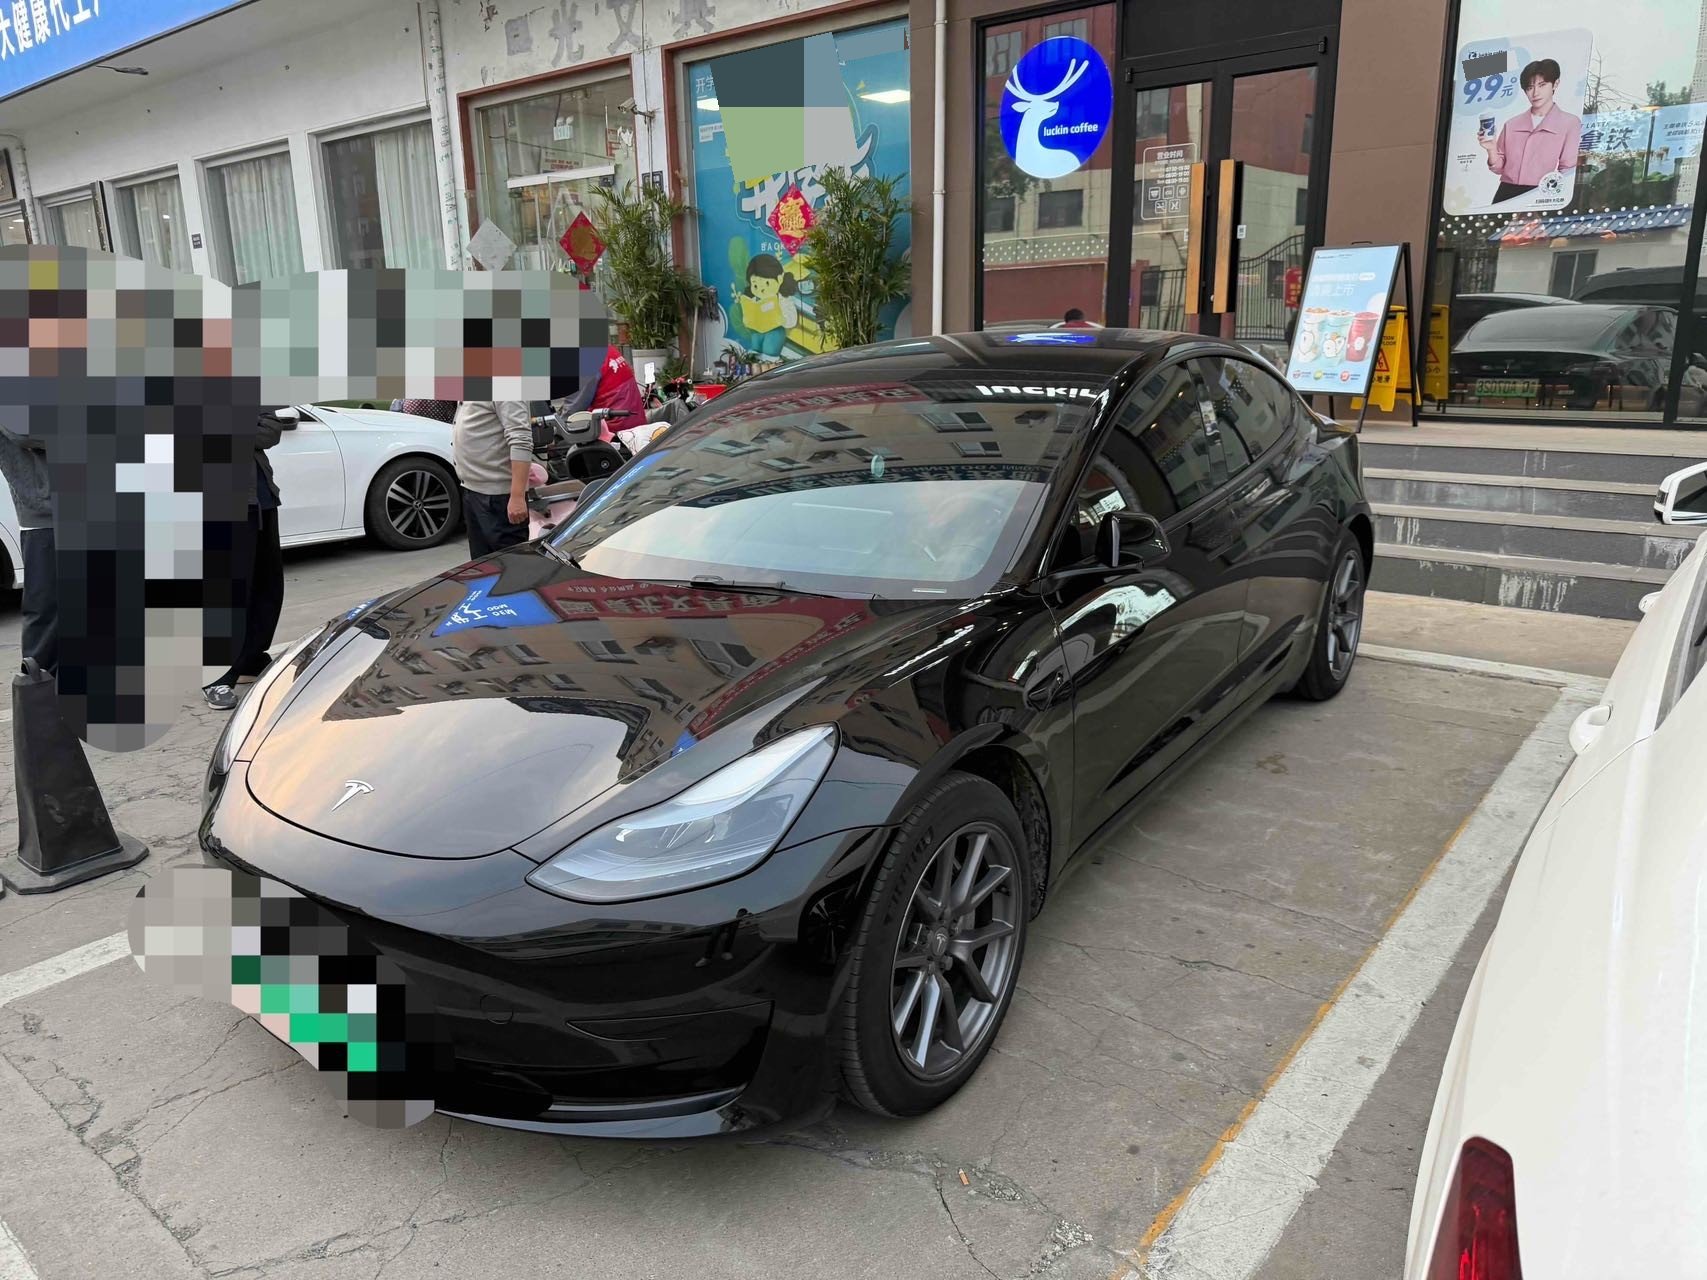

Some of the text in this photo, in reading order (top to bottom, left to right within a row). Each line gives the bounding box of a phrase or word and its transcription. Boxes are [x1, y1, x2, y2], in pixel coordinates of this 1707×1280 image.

[0, 0, 100, 61] 大健康代工
[1043, 122, 1099, 137] luckin coffee
